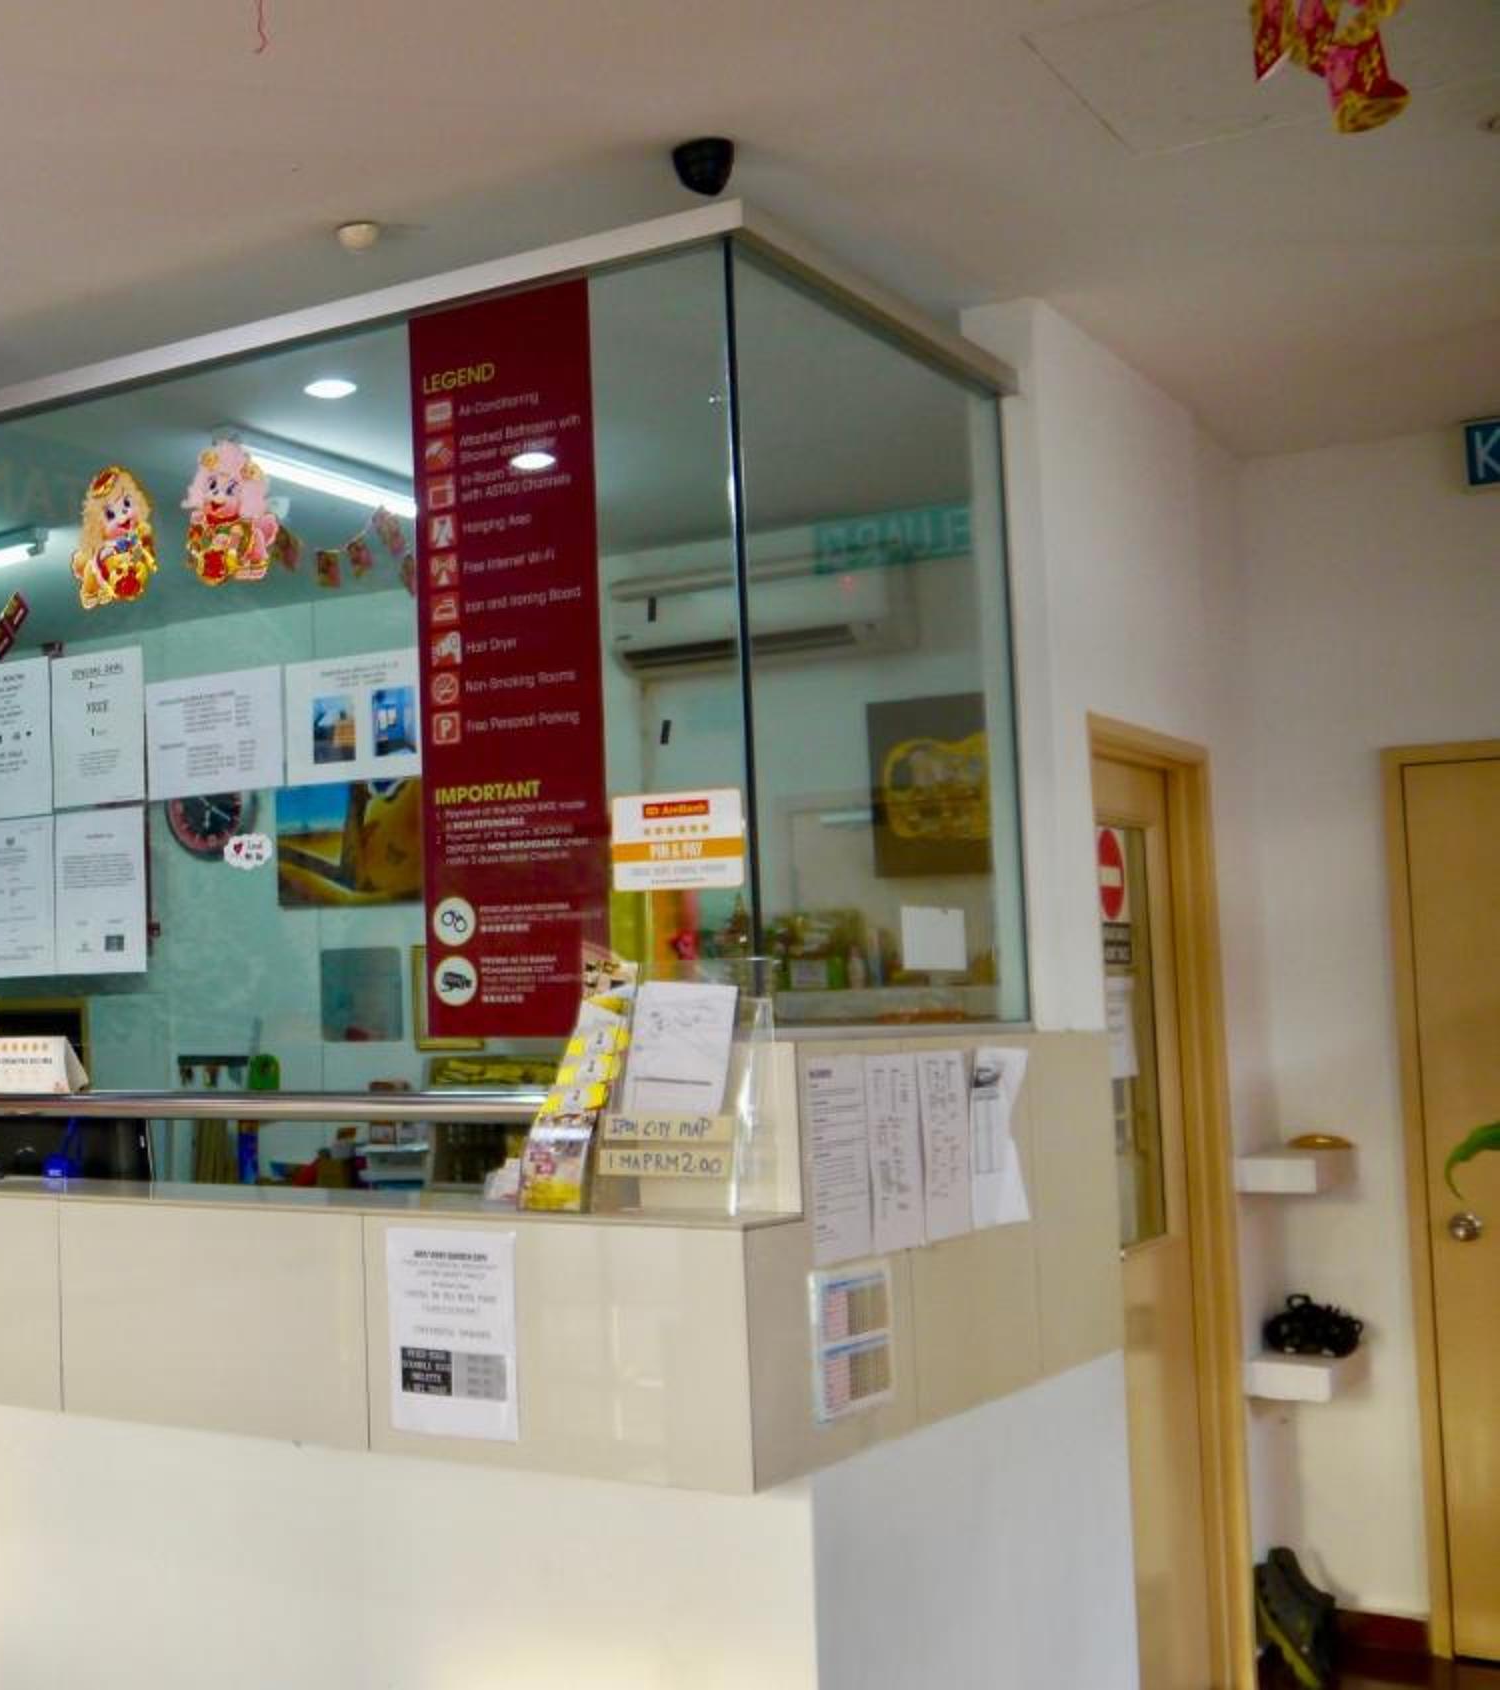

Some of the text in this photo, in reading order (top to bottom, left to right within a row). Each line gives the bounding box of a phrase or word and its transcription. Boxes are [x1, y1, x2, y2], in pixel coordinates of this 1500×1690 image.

[423, 362, 495, 394] LEGEND
[505, 420, 557, 439] Bathroom
[559, 414, 581, 429] with
[462, 473, 572, 504] with ASTRO Channels
[462, 513, 532, 535] Hanging Area
[462, 547, 555, 574] Free Internet Wi-Fi
[465, 601, 485, 614] Iron
[486, 595, 508, 609] and
[549, 586, 581, 602] Board
[466, 637, 517, 654] Hair Dryer
[465, 670, 576, 693] Non-Smoking Rooms
[467, 718, 488, 733] Free
[489, 713, 536, 731] Personal
[538, 711, 580, 725] Parking
[435, 779, 541, 805] IMPORTANT
[662, 802, 707, 814] AmBank
[644, 1120, 671, 1136] CITY
[679, 1117, 712, 1136] MAP
